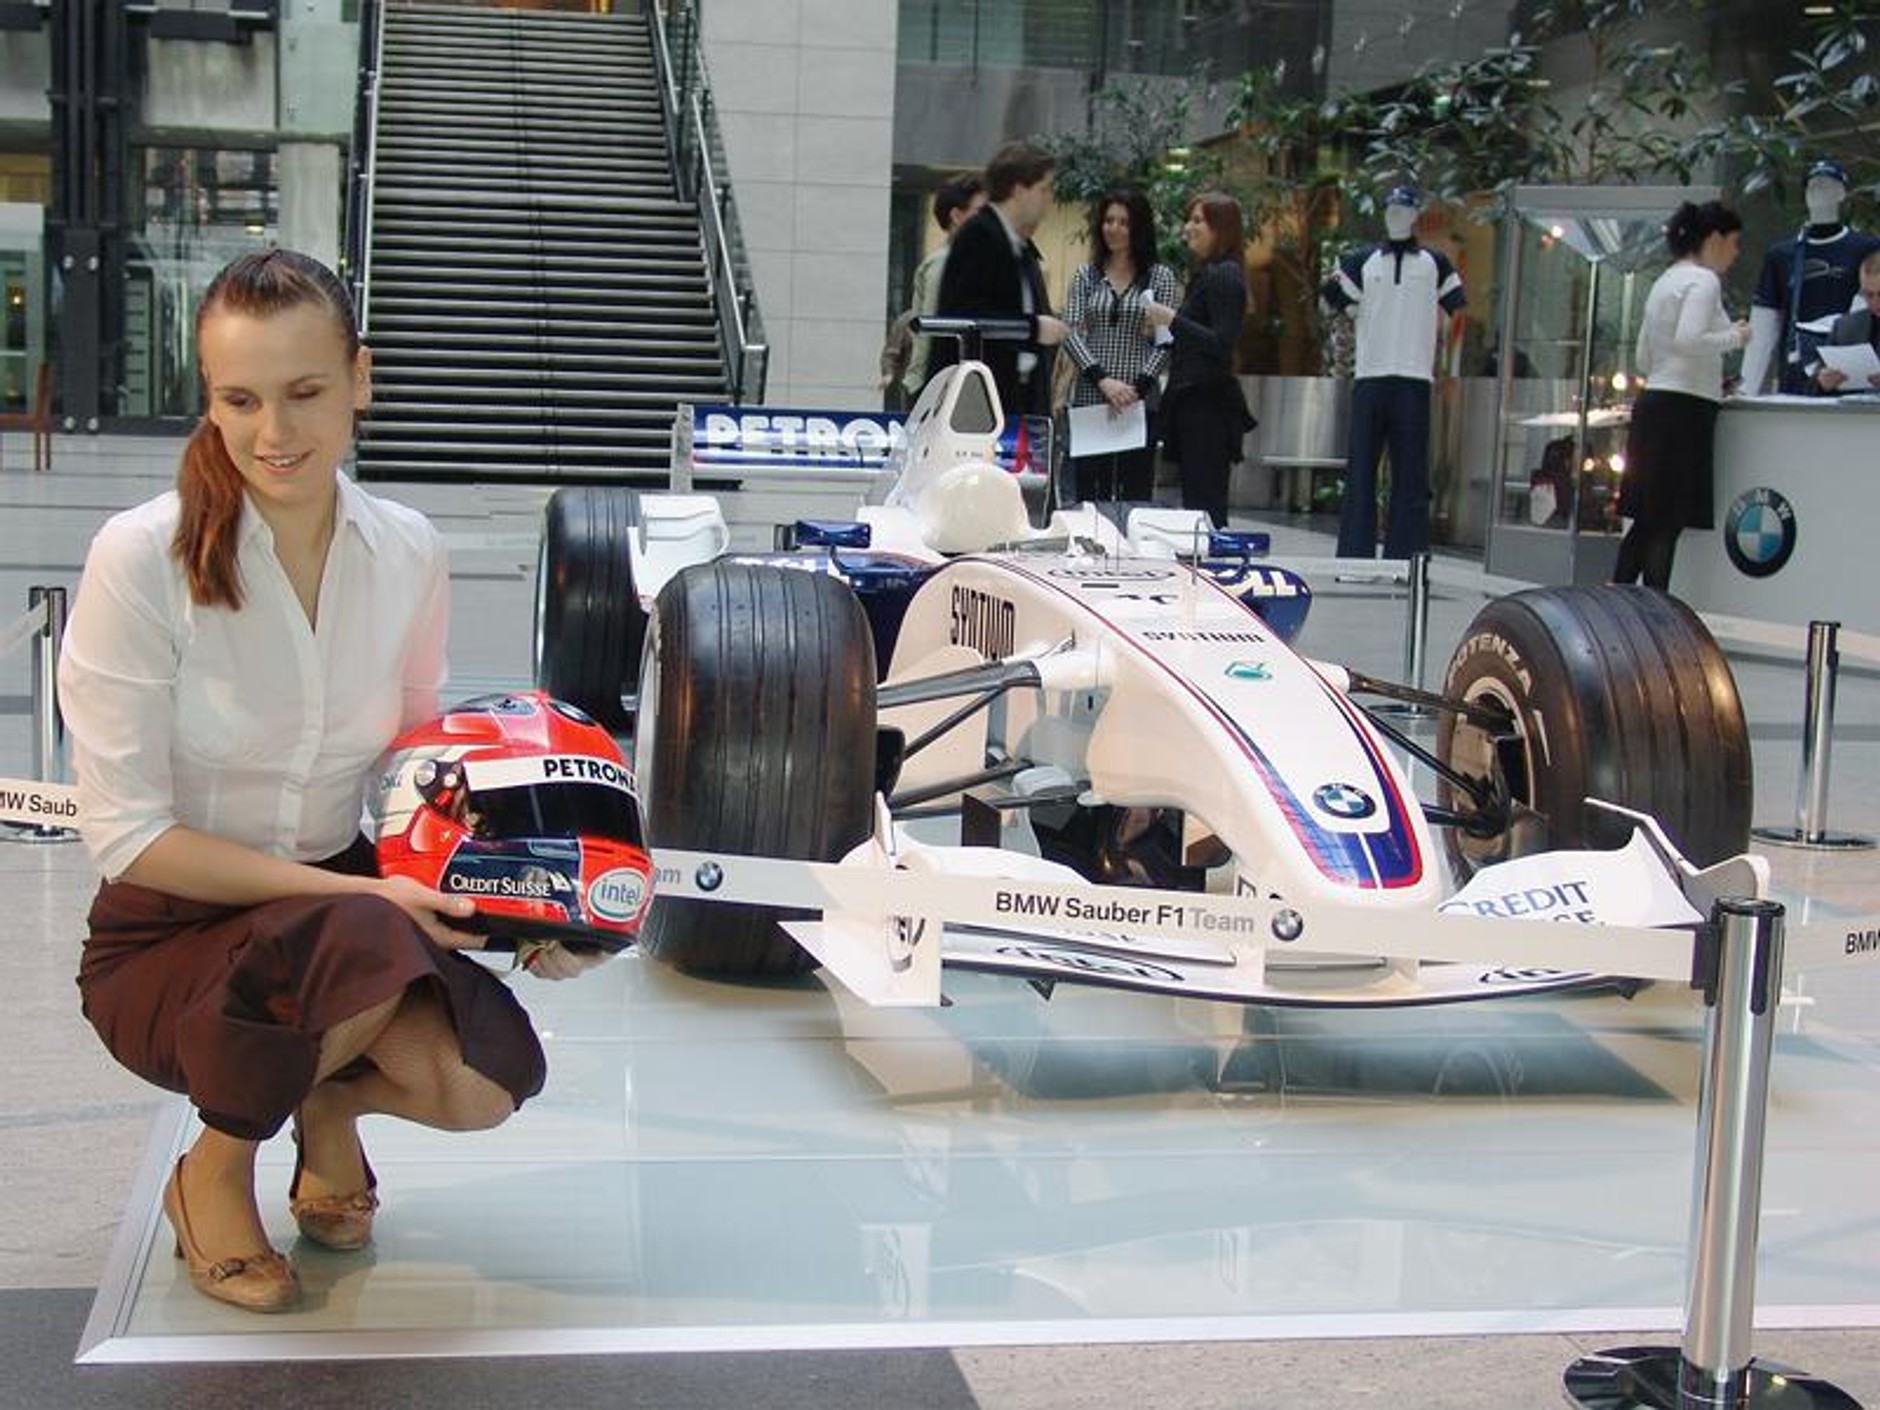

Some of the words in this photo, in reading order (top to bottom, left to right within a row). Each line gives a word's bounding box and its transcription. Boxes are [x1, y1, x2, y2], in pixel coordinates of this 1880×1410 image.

[28, 794, 77, 817] Saub
[450, 873, 500, 894] CREDIT
[501, 876, 552, 897] SUISSE
[600, 879, 641, 905] intel
[995, 891, 1060, 916] BMW
[1064, 897, 1150, 924] Sauber
[1156, 904, 1185, 927] F1
[1188, 907, 1254, 934] Team
[1845, 928, 1880, 954] BM
